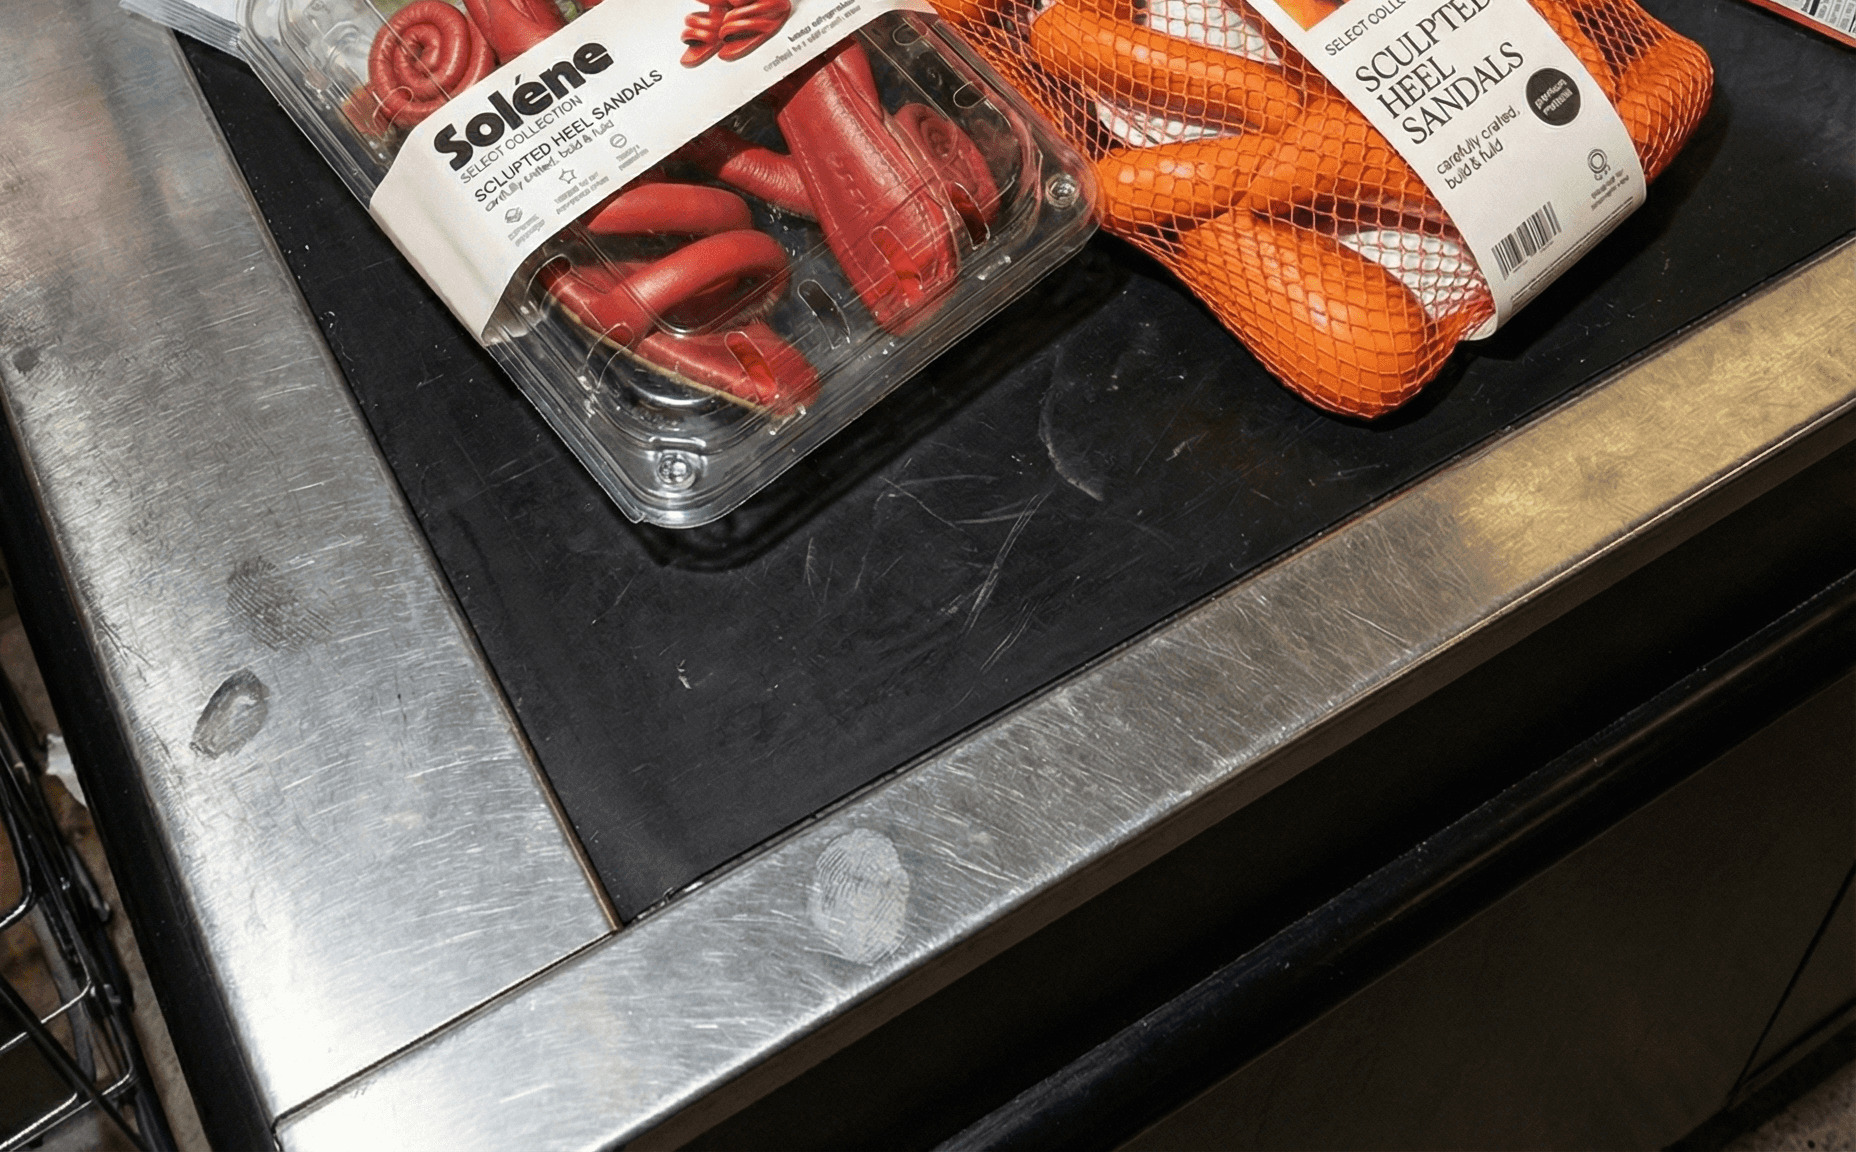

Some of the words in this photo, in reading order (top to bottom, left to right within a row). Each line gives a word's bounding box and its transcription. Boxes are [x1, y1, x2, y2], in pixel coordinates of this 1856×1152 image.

[1324, 19, 1369, 56] SELECT
[433, 42, 615, 172] Soléne
[474, 142, 552, 202] SCLUPTED
[551, 117, 595, 147] HEEL
[592, 69, 663, 120] SANDALS
[1376, 55, 1456, 120] HEEL
[1402, 41, 1525, 145] SANDALS
[460, 145, 506, 184] SELECT
[505, 94, 583, 150] COLLECTION
